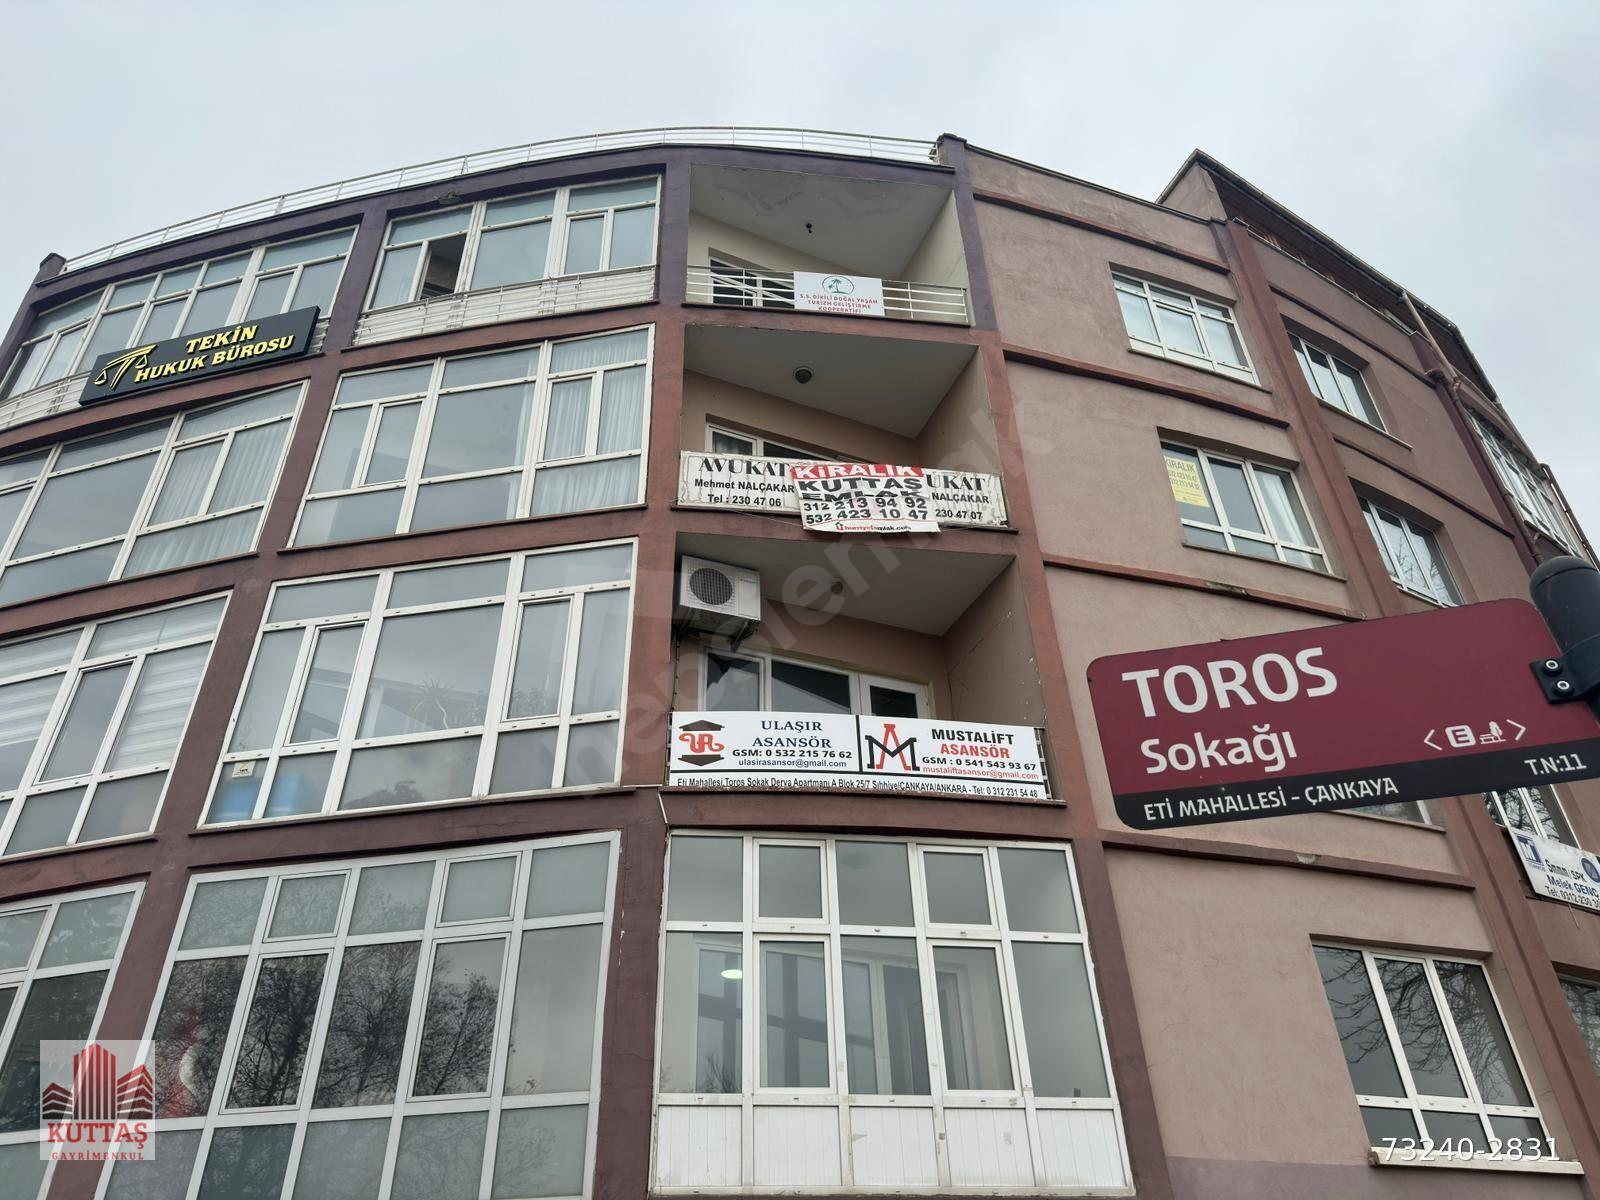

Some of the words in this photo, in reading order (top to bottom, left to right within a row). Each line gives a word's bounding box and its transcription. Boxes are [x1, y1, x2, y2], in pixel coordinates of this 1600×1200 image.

[186, 325, 258, 354] TEKİN
[134, 354, 207, 383] HUKUK
[212, 335, 294, 366] BÜROSU
[699, 457, 790, 477] AVUKAT
[694, 478, 735, 490] Mehmet
[738, 481, 795, 494] NALÇAKAR
[926, 474, 986, 490] UKAT
[707, 494, 723, 504] Tel
[732, 495, 751, 505] 230
[754, 497, 767, 507] 47
[769, 497, 782, 507] 06
[802, 490, 928, 502] EMLAK
[931, 492, 990, 504] NALÇAKAR
[803, 502, 830, 512] 312
[834, 497, 868, 510] 213
[875, 497, 897, 508] 94
[904, 497, 927, 509] 92
[806, 513, 832, 524] 532
[837, 509, 871, 519] 423
[880, 508, 901, 519] 10
[908, 509, 928, 520] 47
[935, 508, 953, 518] 230
[956, 510, 968, 520] 47
[970, 511, 984, 521] 07
[1121, 646, 1338, 718] TOROS
[761, 720, 823, 734] ULAŞIR
[752, 735, 832, 749] ASANSÖR
[931, 728, 1014, 745] MUSTALİFT
[732, 749, 763, 757] GSM:
[766, 749, 772, 757] 0
[775, 750, 796, 758] 532
[799, 750, 819, 758] 215
[822, 750, 836, 758] 76
[839, 751, 852, 759] 62
[940, 743, 1010, 759] ASANSÖR
[1140, 723, 1298, 774] Sokağı
[738, 759, 847, 769] ulasirasansor@gmail.com
[922, 756, 947, 765] GSM
[956, 758, 962, 766] 0
[965, 759, 984, 767] 541
[987, 760, 1006, 769] 543
[1009, 762, 1022, 770] 93
[1024, 763, 1036, 771] 67
[1524, 753, 1587, 776] T.N:11
[922, 765, 1039, 780] mustaliftasansor@gmail.com
[747, 778, 769, 787] Sokak
[838, 779, 854, 788] Blok
[993, 787, 1005, 796] 312
[1006, 788, 1018, 797] 231
[1020, 789, 1028, 797] 54
[1030, 789, 1038, 798] 48
[1143, 798, 1174, 821] ETİ
[1179, 786, 1287, 818] MAHALLESİ
[1304, 777, 1399, 806] ÇANKAYA
